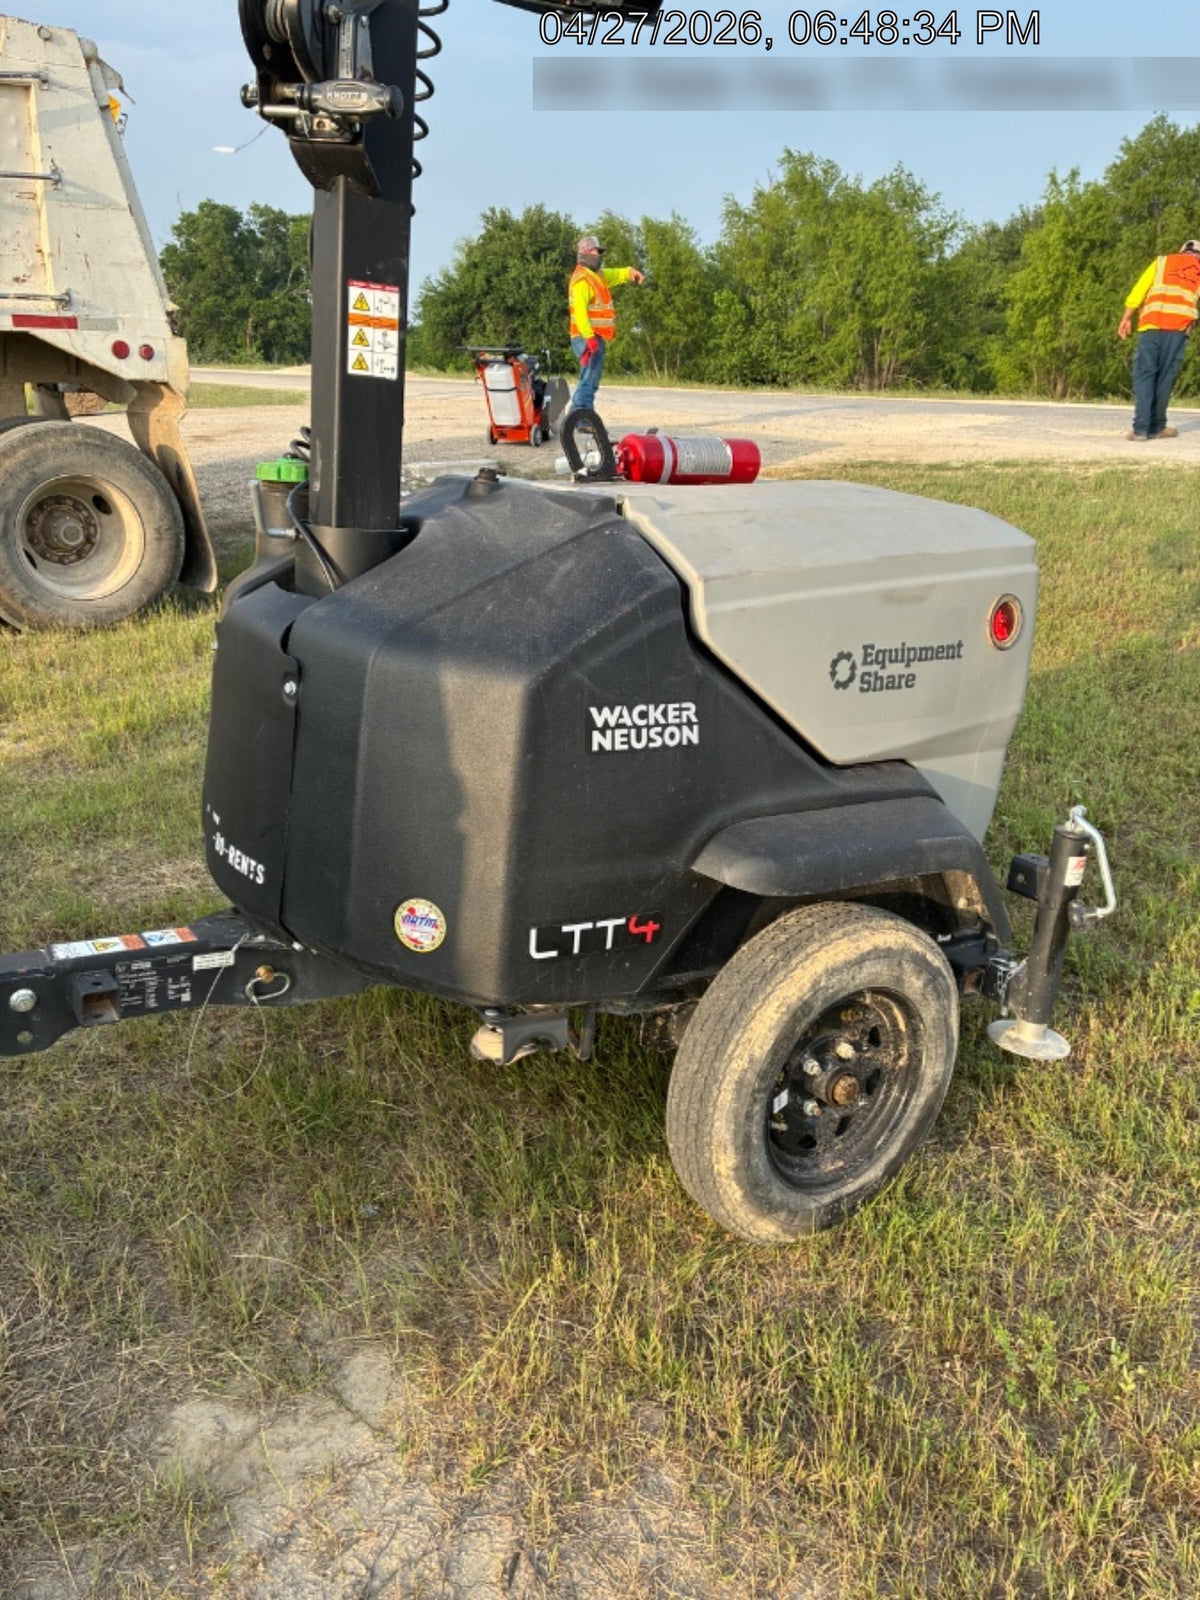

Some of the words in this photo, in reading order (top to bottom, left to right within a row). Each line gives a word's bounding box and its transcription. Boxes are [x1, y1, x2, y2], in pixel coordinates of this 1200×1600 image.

[862, 640, 963, 669] Equipment
[859, 671, 916, 693] Share
[589, 702, 699, 728] WACKER
[591, 725, 700, 752] NEUSON
[529, 915, 660, 960] LTT4
